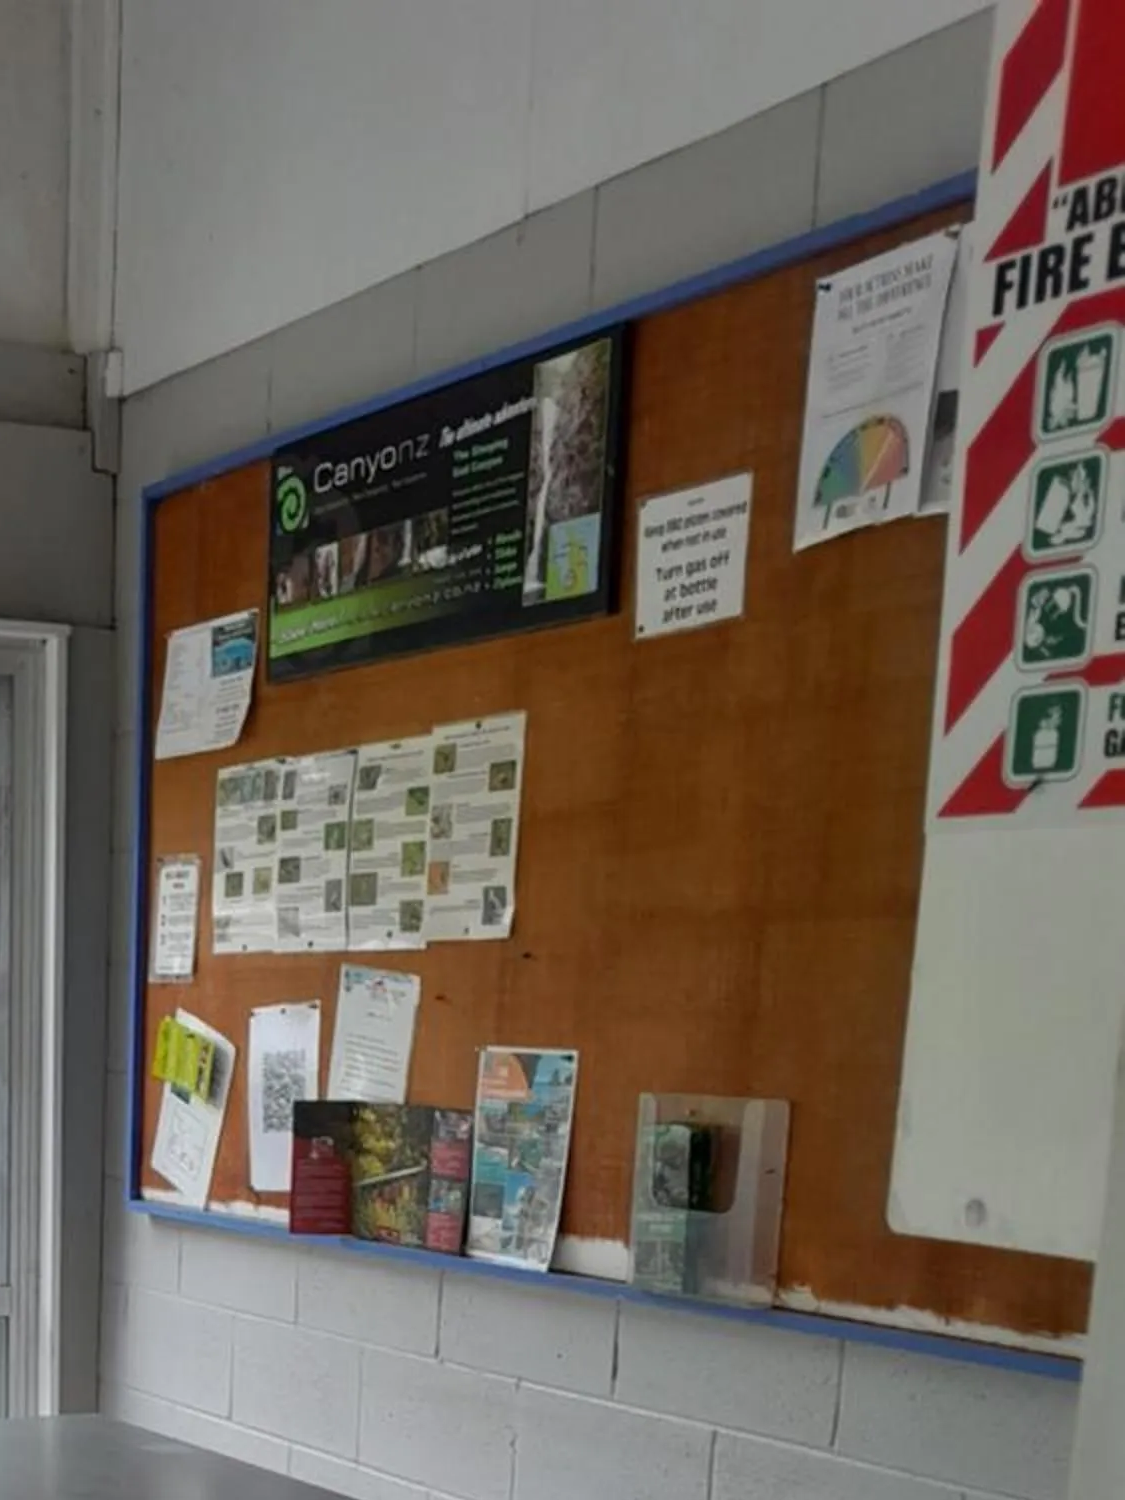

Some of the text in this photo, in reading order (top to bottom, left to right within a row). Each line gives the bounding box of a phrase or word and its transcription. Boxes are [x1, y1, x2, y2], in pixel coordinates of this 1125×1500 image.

[992, 231, 1094, 317] FIRE
[313, 433, 430, 494] Canyonz
[656, 549, 731, 582] Turn gas off
[679, 577, 718, 599] bottle
[662, 598, 718, 624] after use
